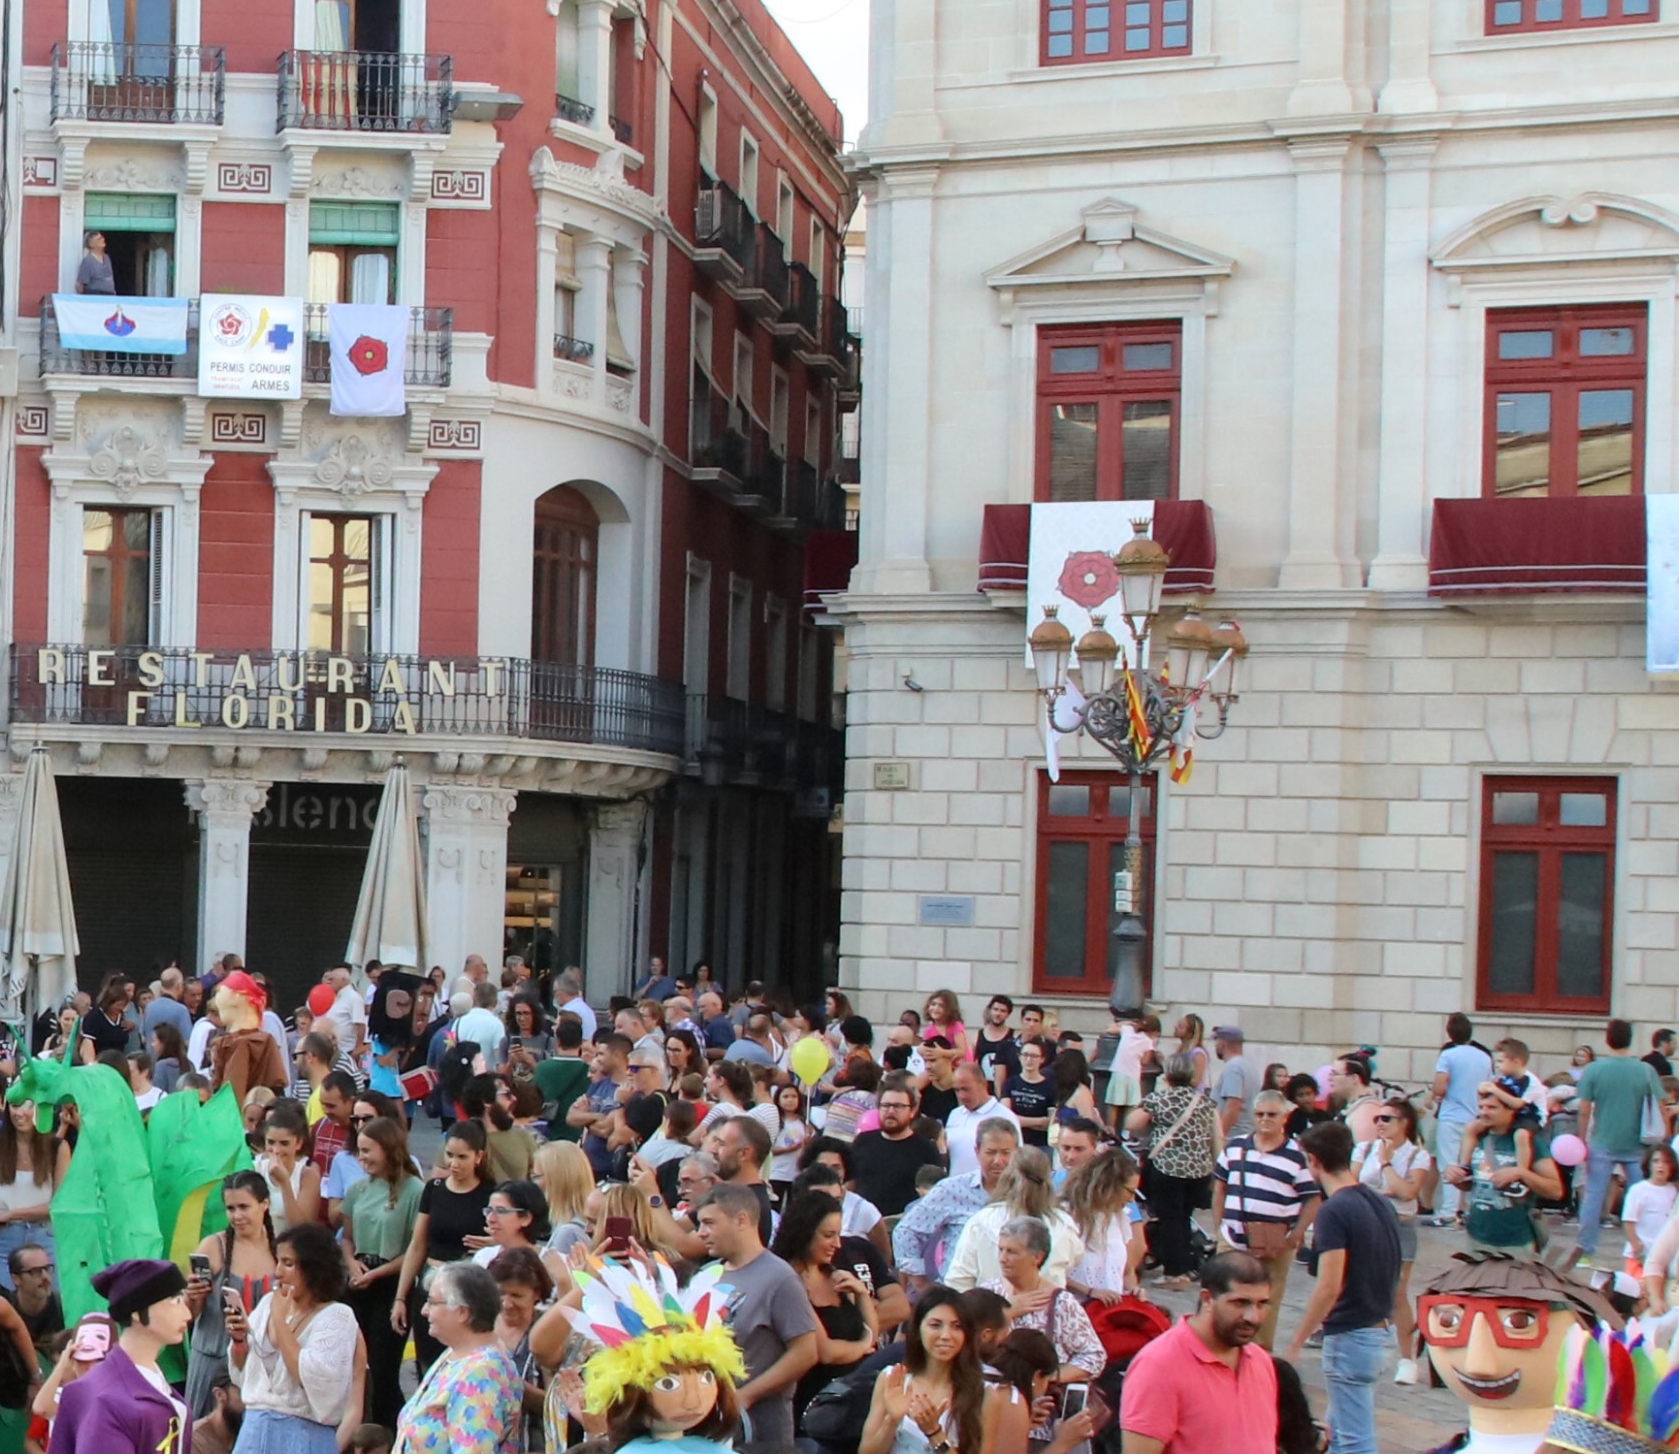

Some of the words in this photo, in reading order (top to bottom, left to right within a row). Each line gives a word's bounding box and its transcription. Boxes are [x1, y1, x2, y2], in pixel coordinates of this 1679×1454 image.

[248, 363, 291, 375] CONDUIR
[251, 380, 290, 392] ARMES
[37, 648, 506, 698] RESTAURANT
[126, 690, 418, 735] FLORIDA
